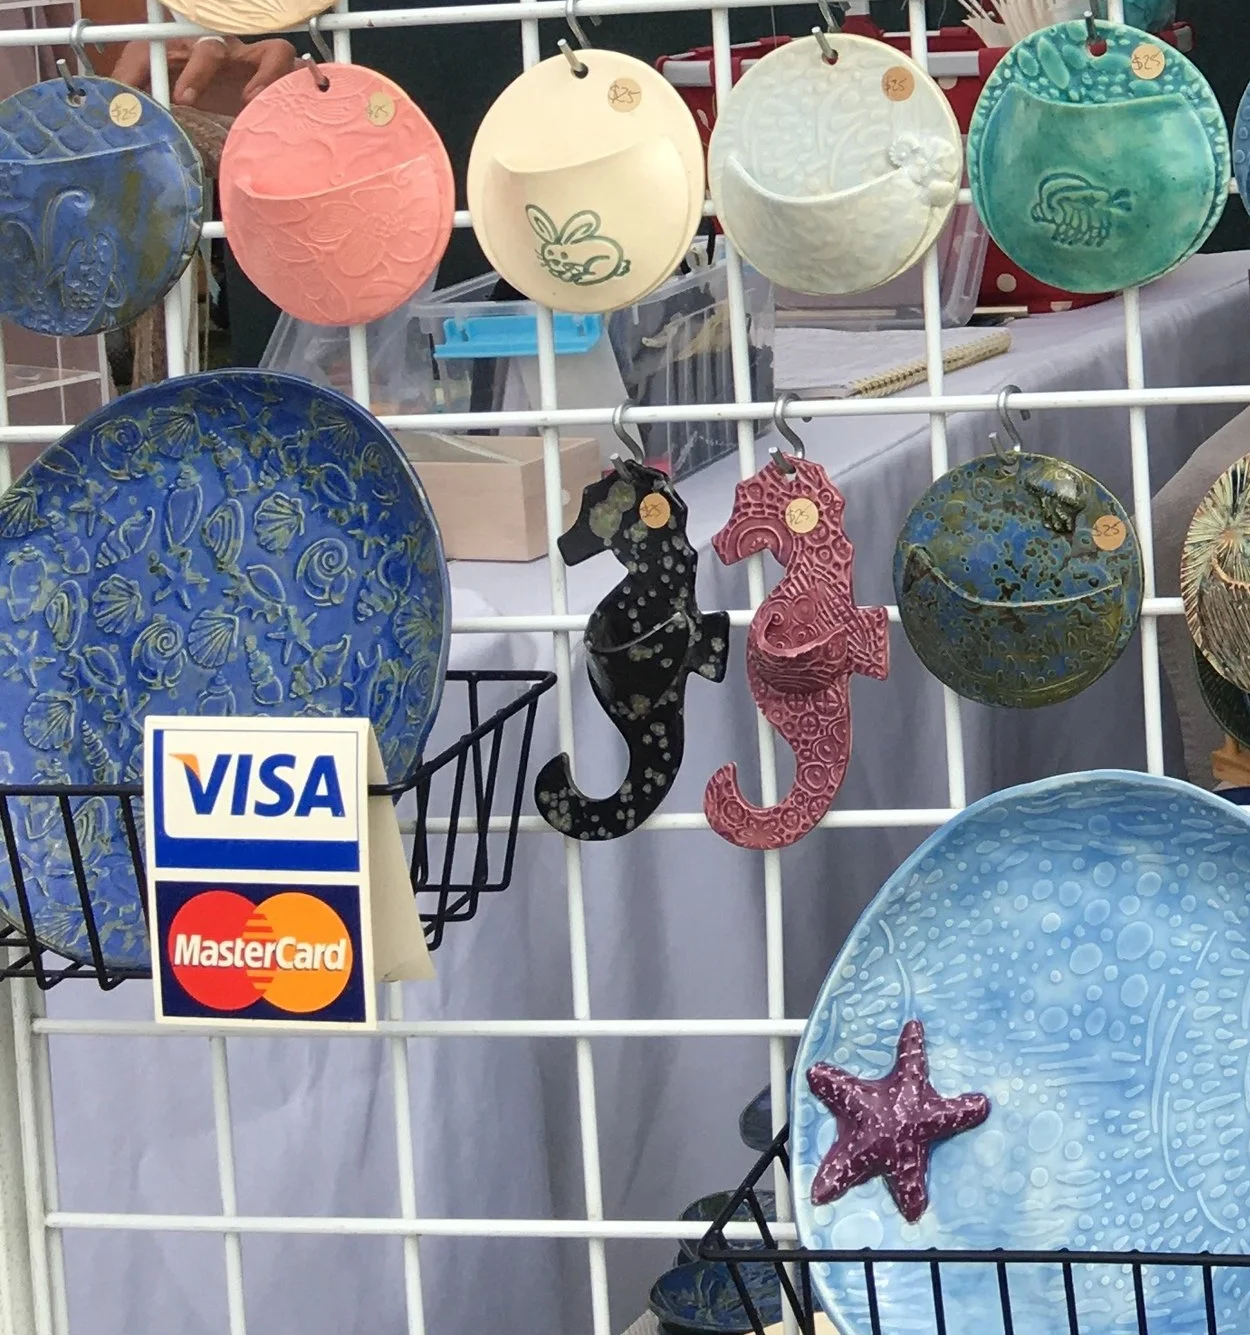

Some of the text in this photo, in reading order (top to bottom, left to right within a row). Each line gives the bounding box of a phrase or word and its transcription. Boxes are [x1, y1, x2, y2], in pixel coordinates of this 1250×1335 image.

[1132, 51, 1161, 70] $25
[609, 82, 641, 104] $25
[885, 75, 908, 95] $25
[111, 103, 138, 122] $25
[640, 501, 660, 519] $25
[788, 503, 811, 525] $25
[1093, 522, 1121, 537] $25
[168, 753, 347, 818] VISA
[173, 933, 347, 971] MasterCard
